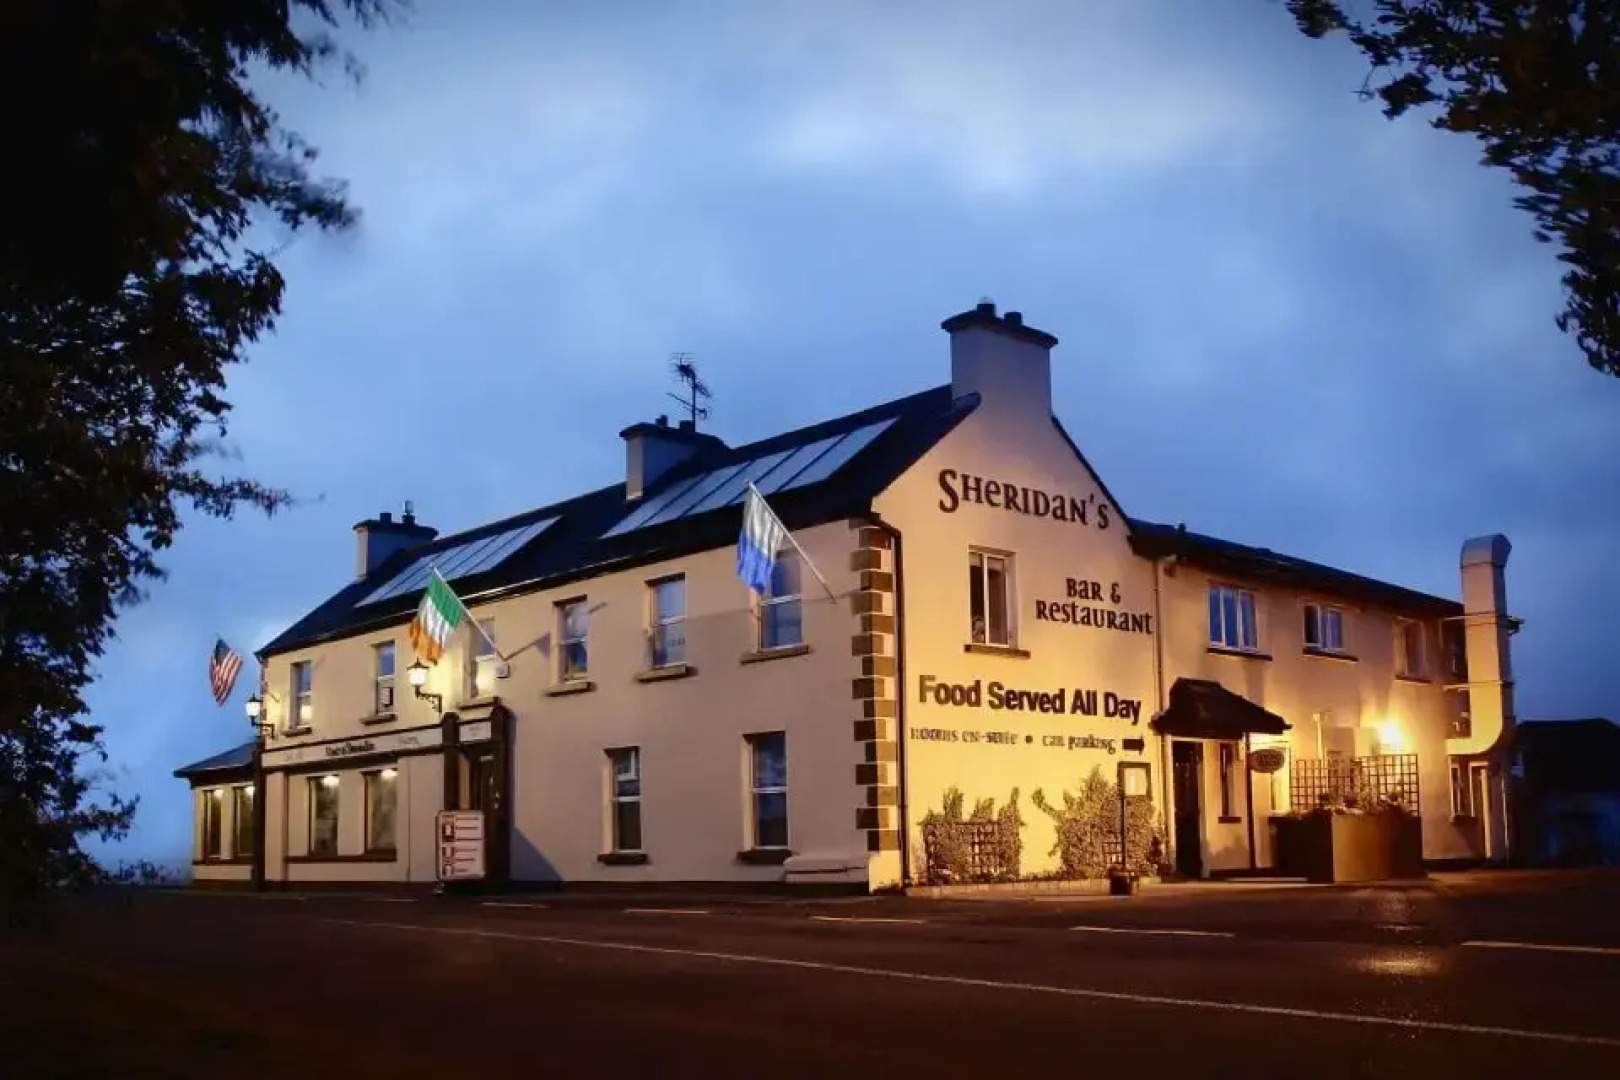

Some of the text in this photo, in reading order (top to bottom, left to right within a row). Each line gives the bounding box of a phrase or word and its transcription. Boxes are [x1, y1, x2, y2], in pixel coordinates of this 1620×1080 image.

[1110, 582, 1121, 604] &
[919, 674, 1141, 725] Food Served All Day
